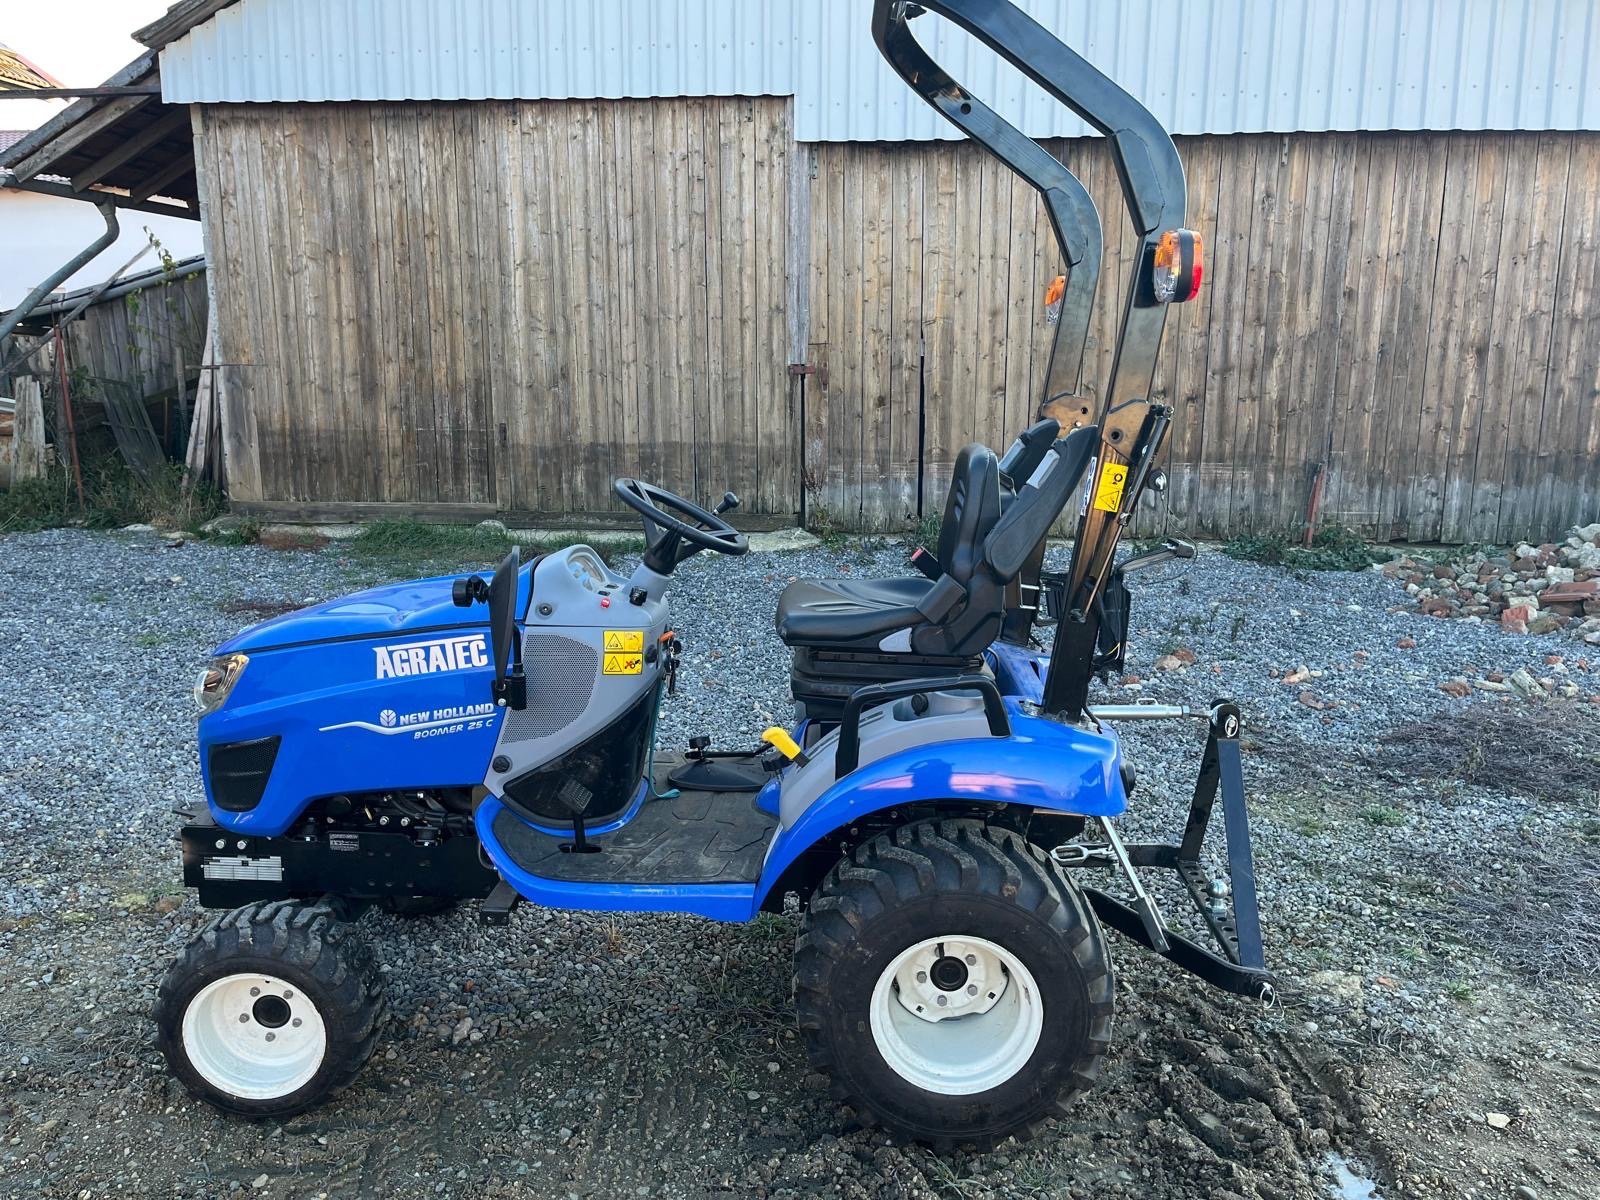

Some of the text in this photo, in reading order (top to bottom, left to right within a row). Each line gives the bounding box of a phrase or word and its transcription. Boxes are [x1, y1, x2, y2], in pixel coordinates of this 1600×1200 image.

[372, 634, 488, 680] AGRATEC
[400, 703, 494, 725] NEW HOLLAND
[414, 719, 493, 739] BOOMER 25 C
